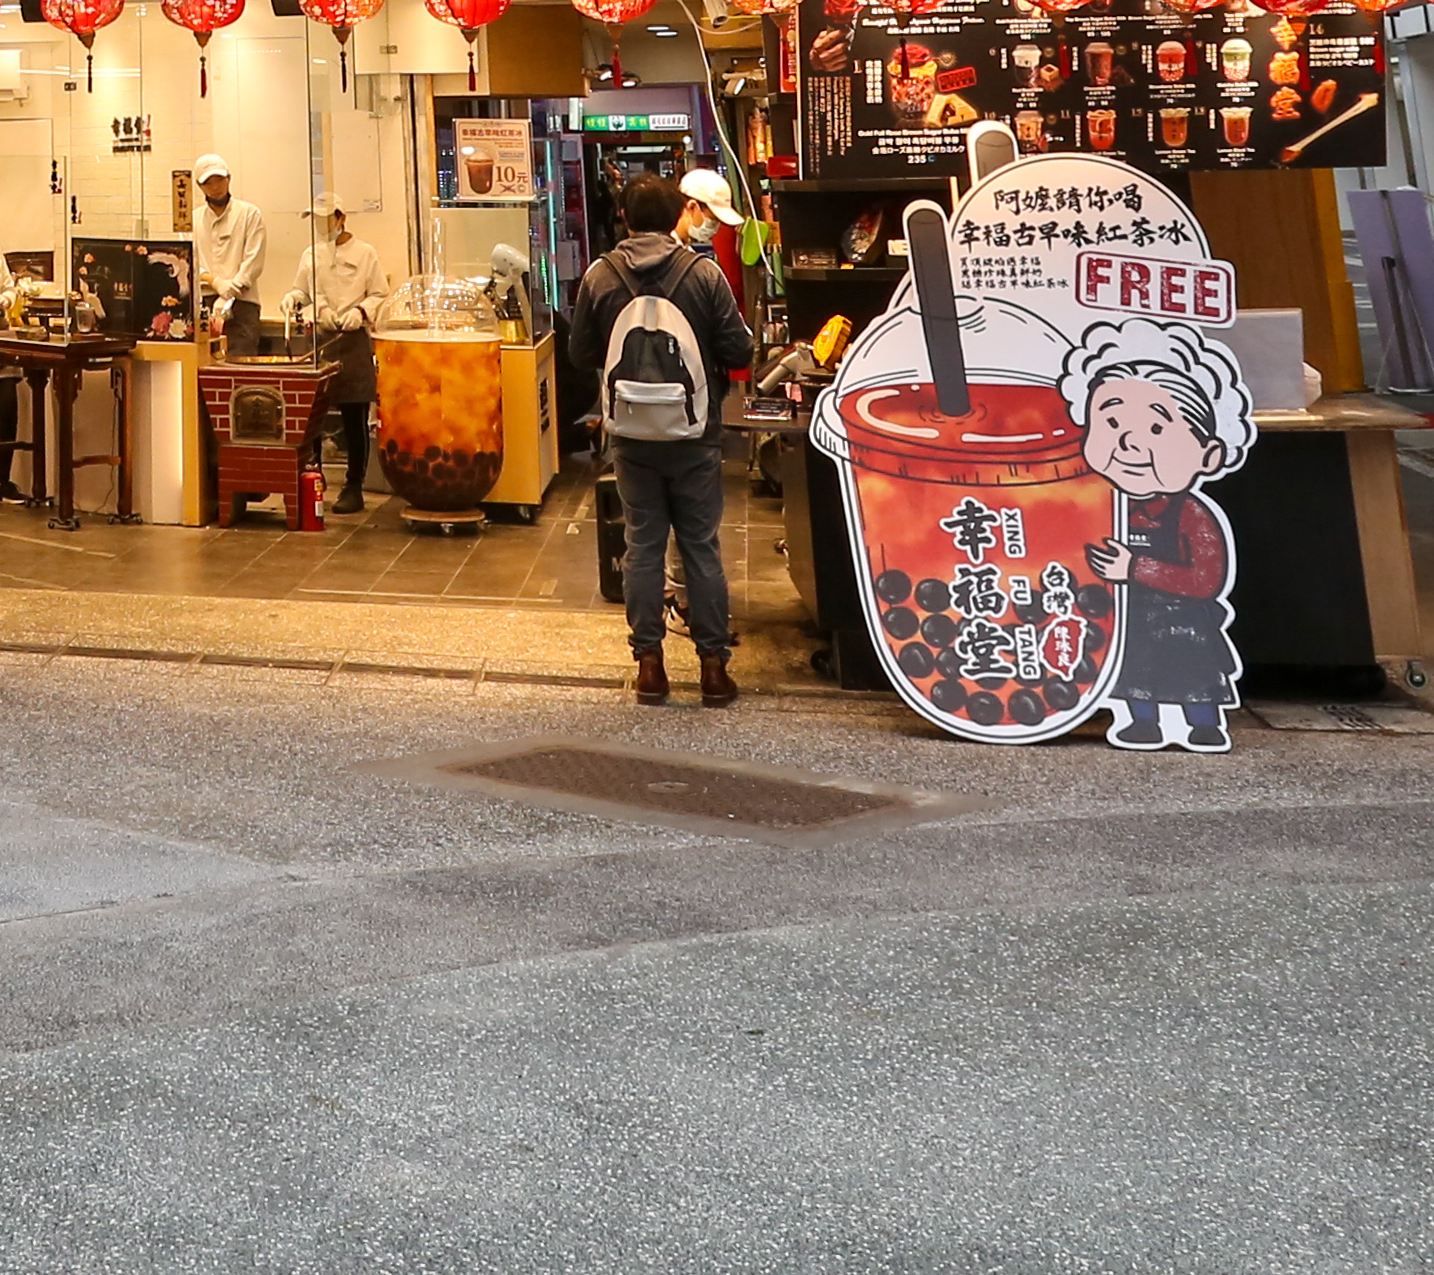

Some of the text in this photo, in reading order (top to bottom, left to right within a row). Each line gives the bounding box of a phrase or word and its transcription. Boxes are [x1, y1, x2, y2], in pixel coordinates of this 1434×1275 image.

[496, 165, 529, 184] 10元
[907, 155, 926, 164] 235
[994, 183, 1143, 215] 阿嬤請你喝
[958, 218, 1193, 253] 幸福古早味紅茶冰
[1085, 256, 1222, 318] FREE
[942, 500, 1014, 677] 幸福堂
[1005, 511, 1039, 678] XING FU TANG
[1044, 564, 1071, 615] 台灣
